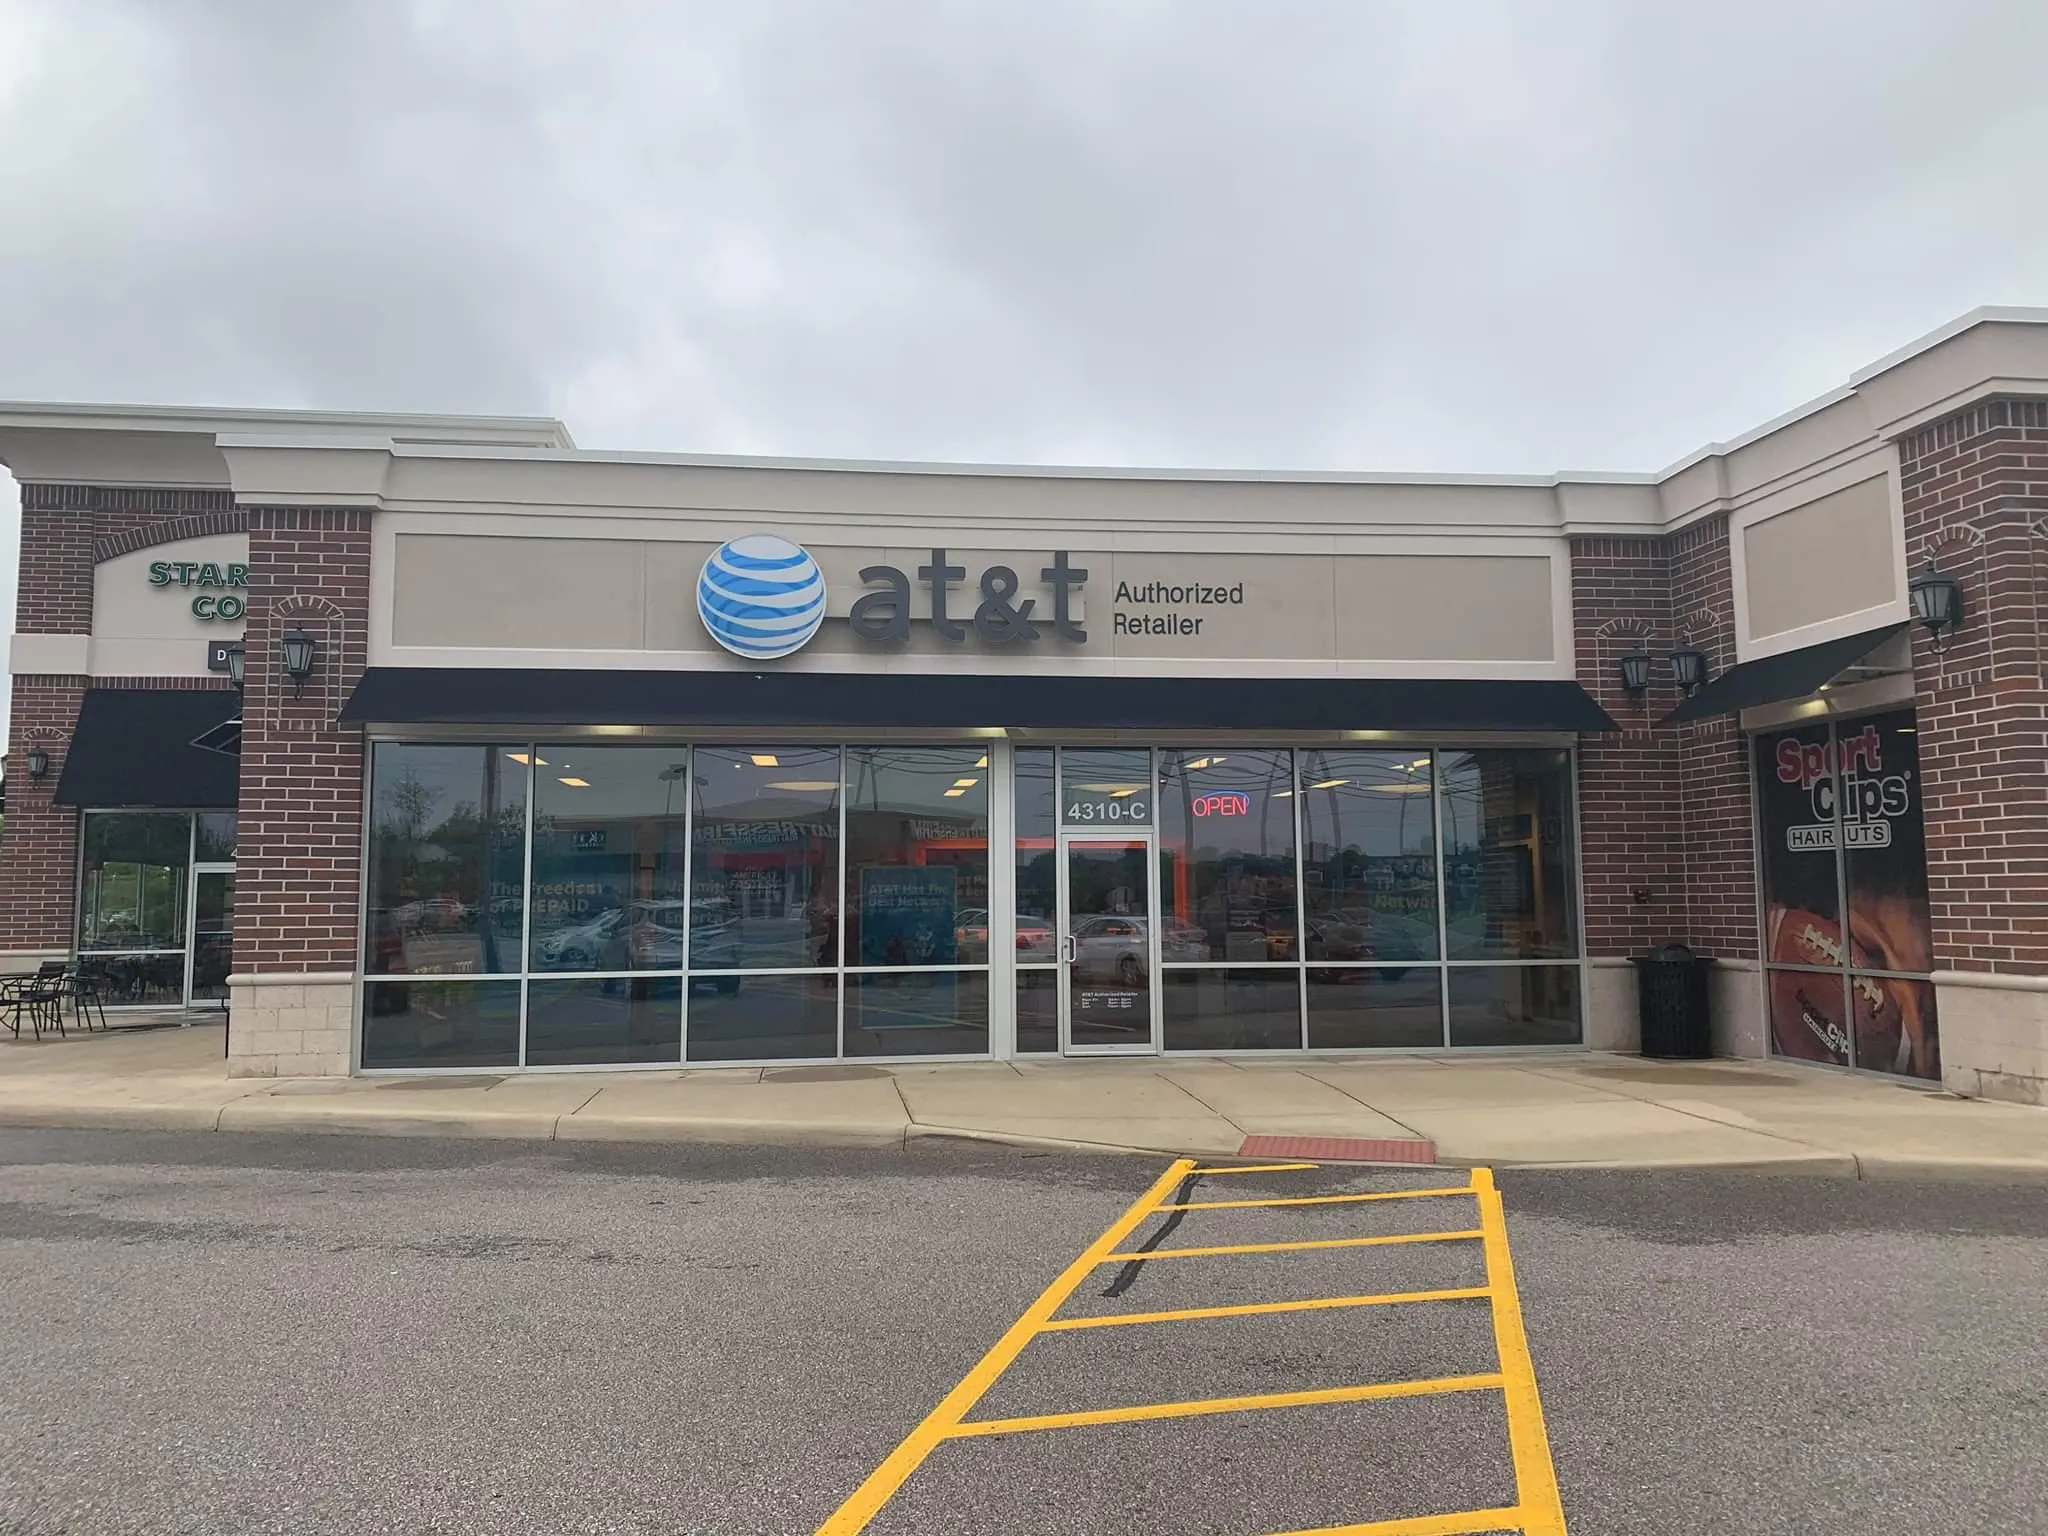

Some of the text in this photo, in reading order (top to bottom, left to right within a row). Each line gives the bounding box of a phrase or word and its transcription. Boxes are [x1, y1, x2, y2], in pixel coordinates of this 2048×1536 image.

[850, 549, 1088, 645] at&t
[1115, 580, 1244, 606] Authorized
[1114, 612, 1204, 636] Retailer
[1776, 724, 1882, 790] Sport
[1067, 801, 1146, 821] 4310-C
[1193, 796, 1249, 818] OPEN
[1791, 825, 1886, 847] HAIRUTS
[513, 899, 589, 913] PEPAID
